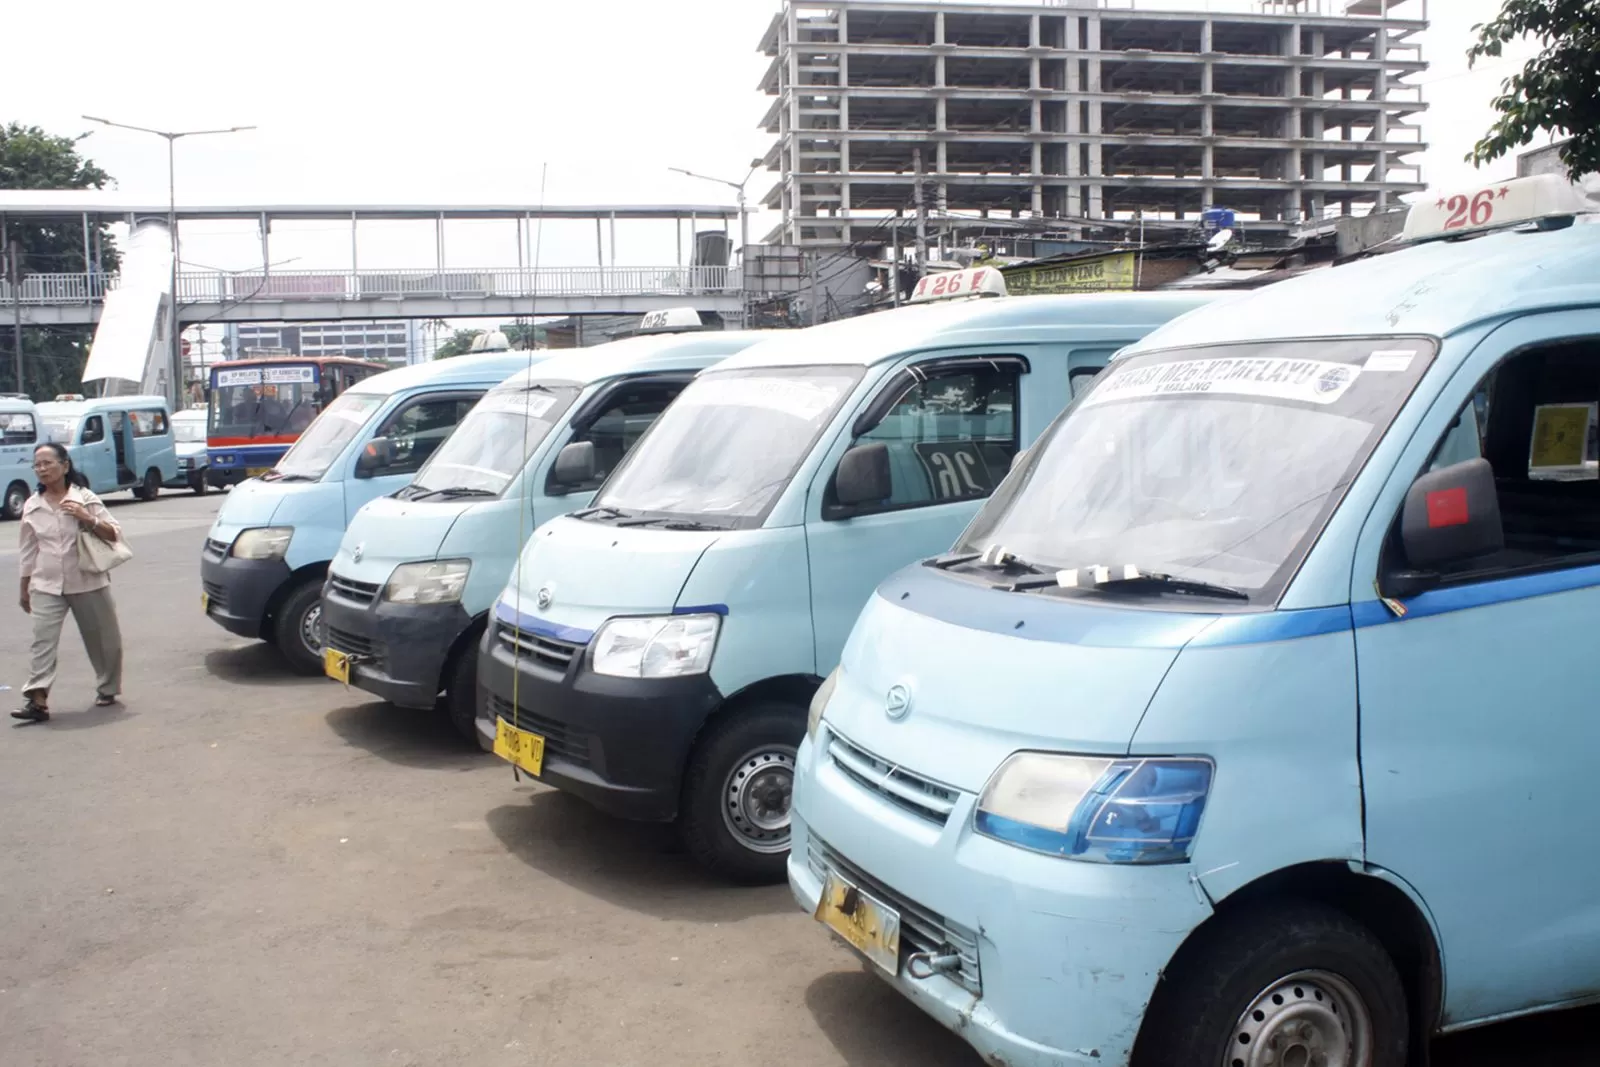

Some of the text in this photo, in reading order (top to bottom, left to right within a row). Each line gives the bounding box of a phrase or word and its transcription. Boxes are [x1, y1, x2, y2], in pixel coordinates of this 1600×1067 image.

[1444, 189, 1495, 231] 26
[932, 273, 963, 295] 26
[1035, 263, 1104, 284] PRINTING
